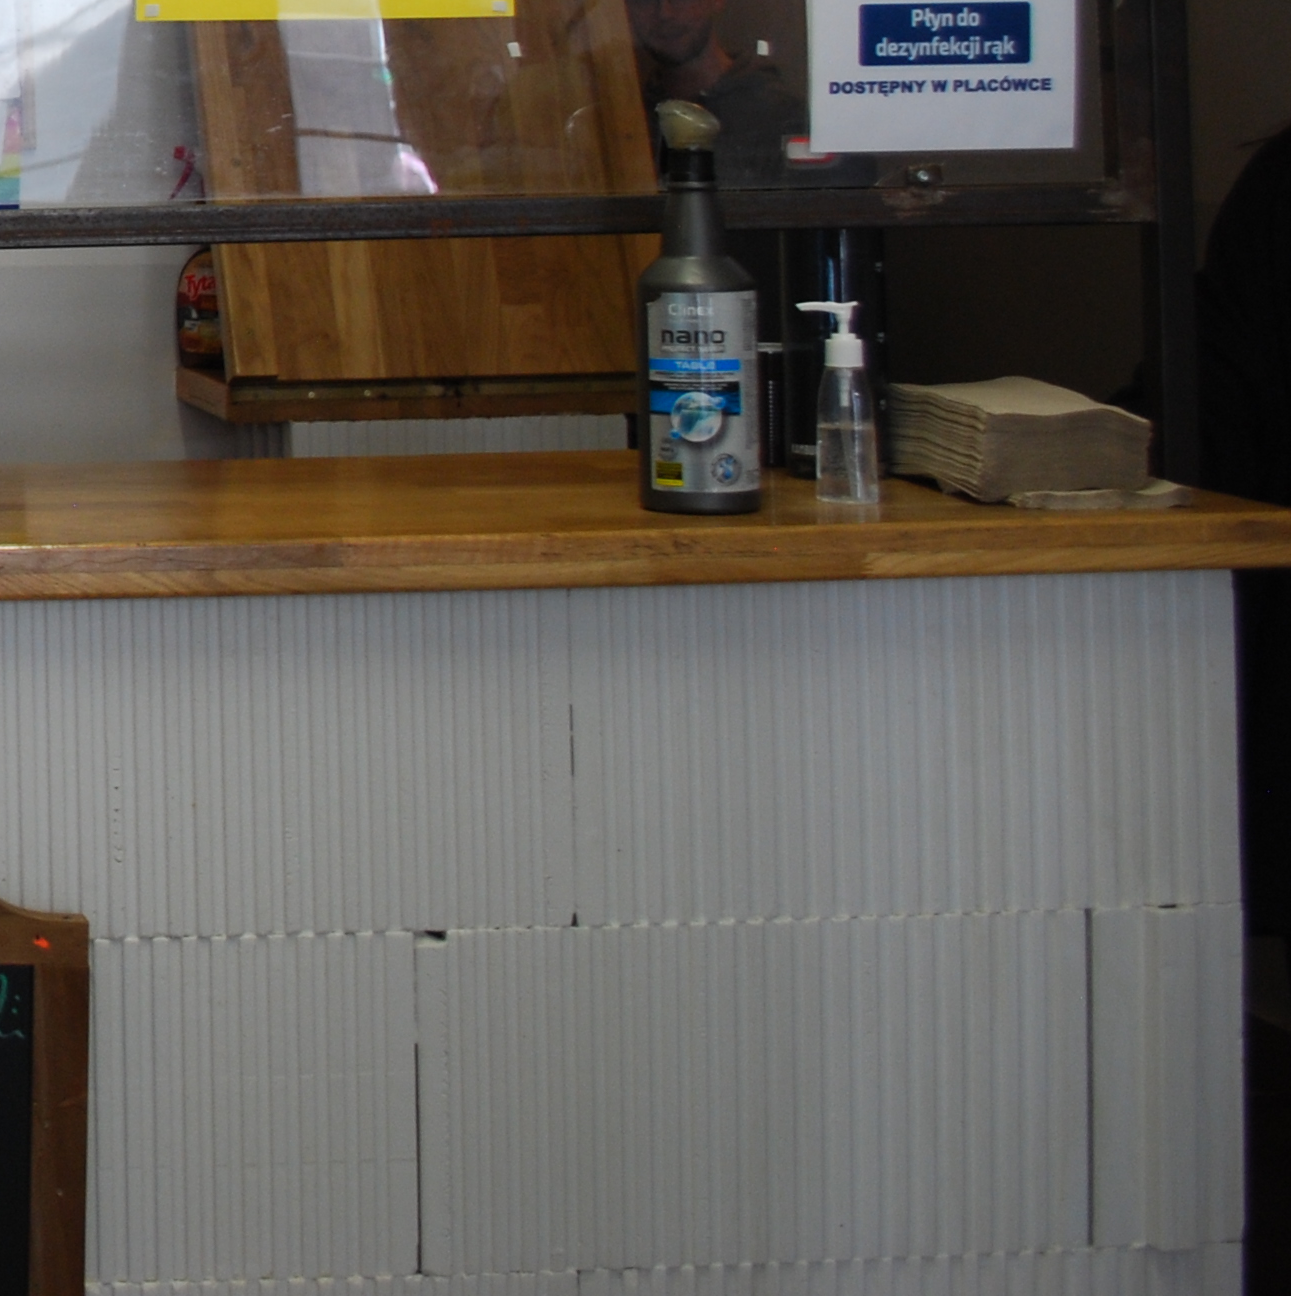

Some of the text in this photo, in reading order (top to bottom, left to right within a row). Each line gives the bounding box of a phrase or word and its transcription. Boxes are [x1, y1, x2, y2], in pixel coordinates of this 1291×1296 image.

[911, 8, 981, 32] Płyn do
[875, 35, 1016, 61] dezynfekcji rąk
[829, 75, 1053, 97] DOSTĘPNY W PLACÓWCE
[661, 329, 726, 344] nano
